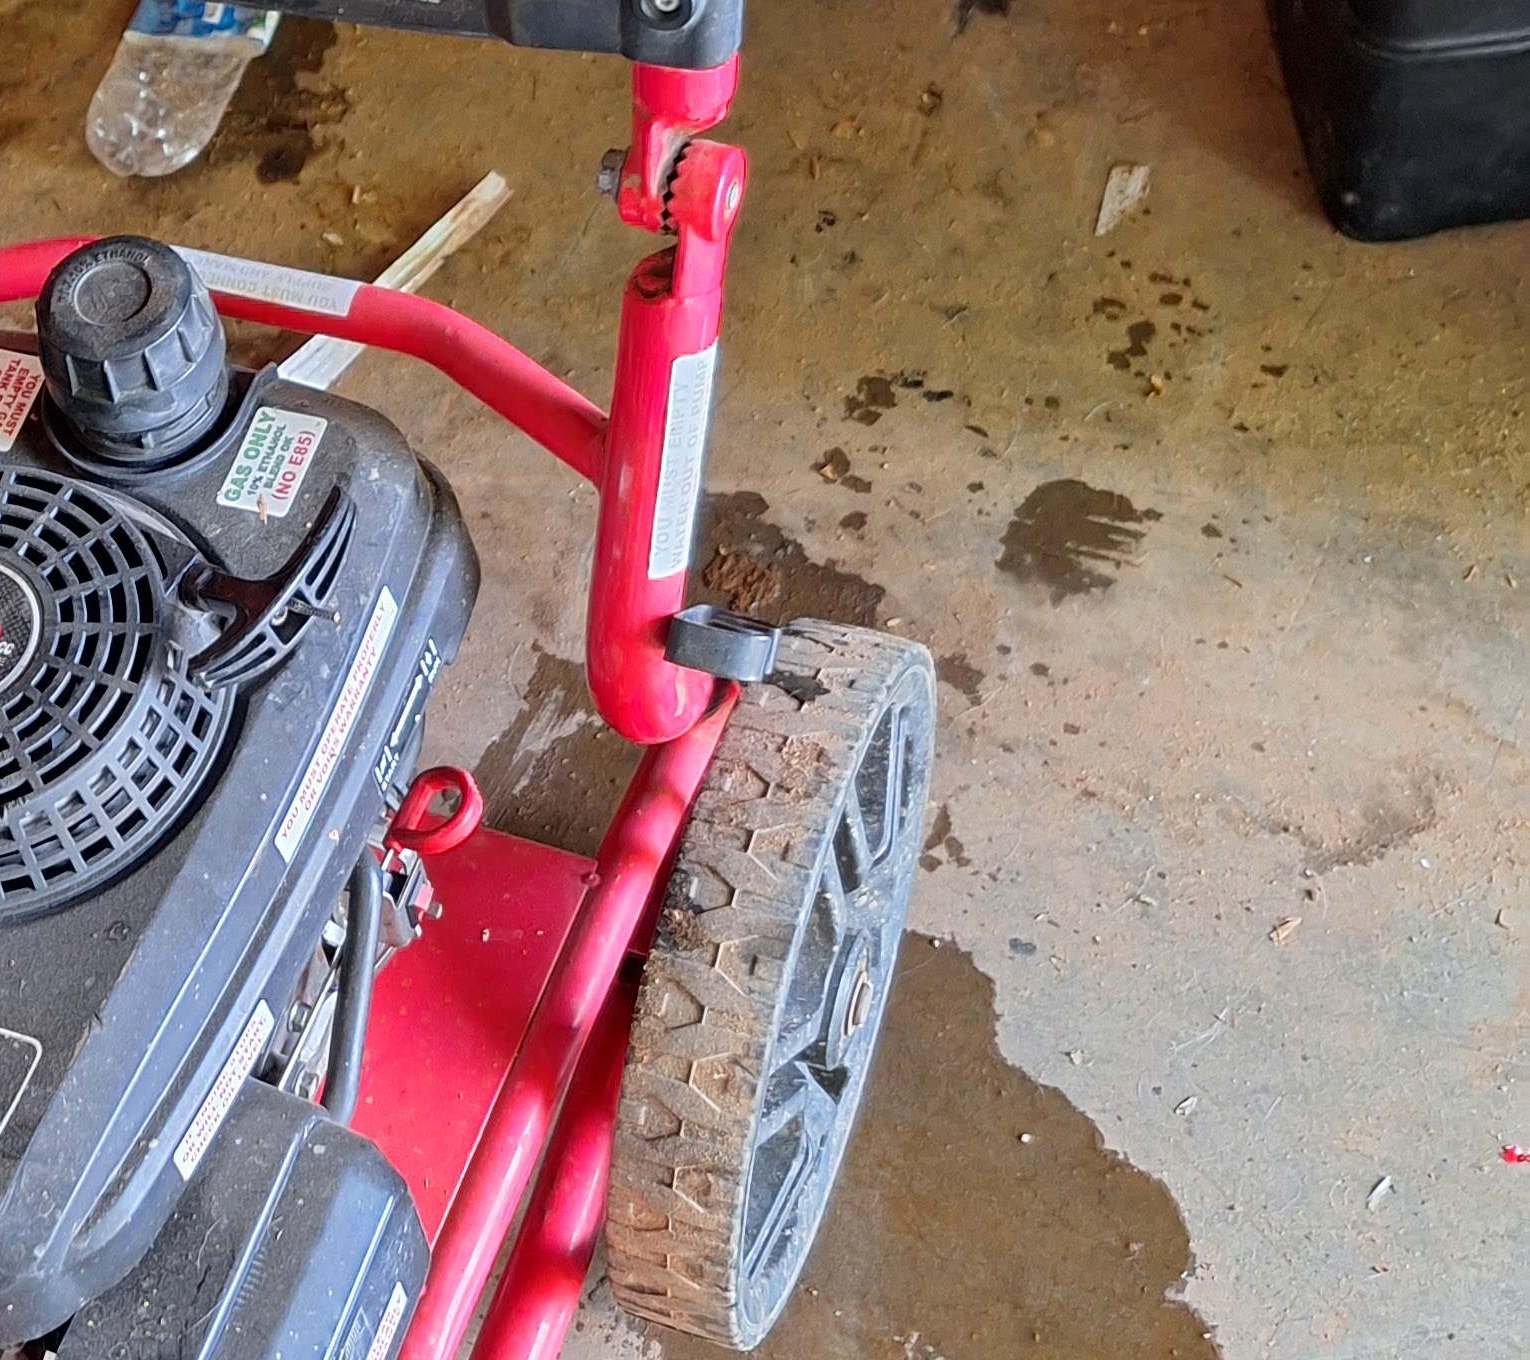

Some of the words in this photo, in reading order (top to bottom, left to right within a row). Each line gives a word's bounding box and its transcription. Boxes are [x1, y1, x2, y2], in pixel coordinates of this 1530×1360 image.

[0, 356, 19, 392] TANK
[4, 366, 27, 409] EMPTY
[21, 371, 39, 399] YOU
[690, 358, 707, 415] PUMP
[4, 400, 24, 436] MUST
[666, 380, 688, 447] EMPTY
[685, 422, 698, 447] OF
[222, 461, 253, 504] GAS
[241, 410, 277, 462] ONLY
[245, 472, 263, 497] 10%
[256, 421, 288, 474] ETHANOL
[262, 452, 286, 490] BLEND
[279, 433, 294, 453] OK
[269, 466, 298, 502] (NO
[285, 427, 316, 468] E85)
[660, 456, 679, 509] MUST
[681, 456, 695, 494] OUT
[653, 511, 672, 557] YOU
[671, 501, 690, 569] WATER
[281, 804, 300, 840] YOU
[298, 756, 321, 805] MUST
[321, 683, 351, 755] OPERATE
[351, 601, 386, 682] PROPERLY
[303, 787, 317, 812] OR
[317, 736, 339, 784] VOIDS
[339, 645, 377, 734] WARRANTY
[380, 751, 400, 792] START
[196, 1068, 227, 1129] ENGINE
[230, 1018, 255, 1068] STOPS
[181, 1139, 195, 1163] OR
[196, 1100, 217, 1139] WILL
[218, 1066, 237, 1099] NOT
[191, 1109, 219, 1164] CHECK
[220, 1084, 234, 1108] OIL
